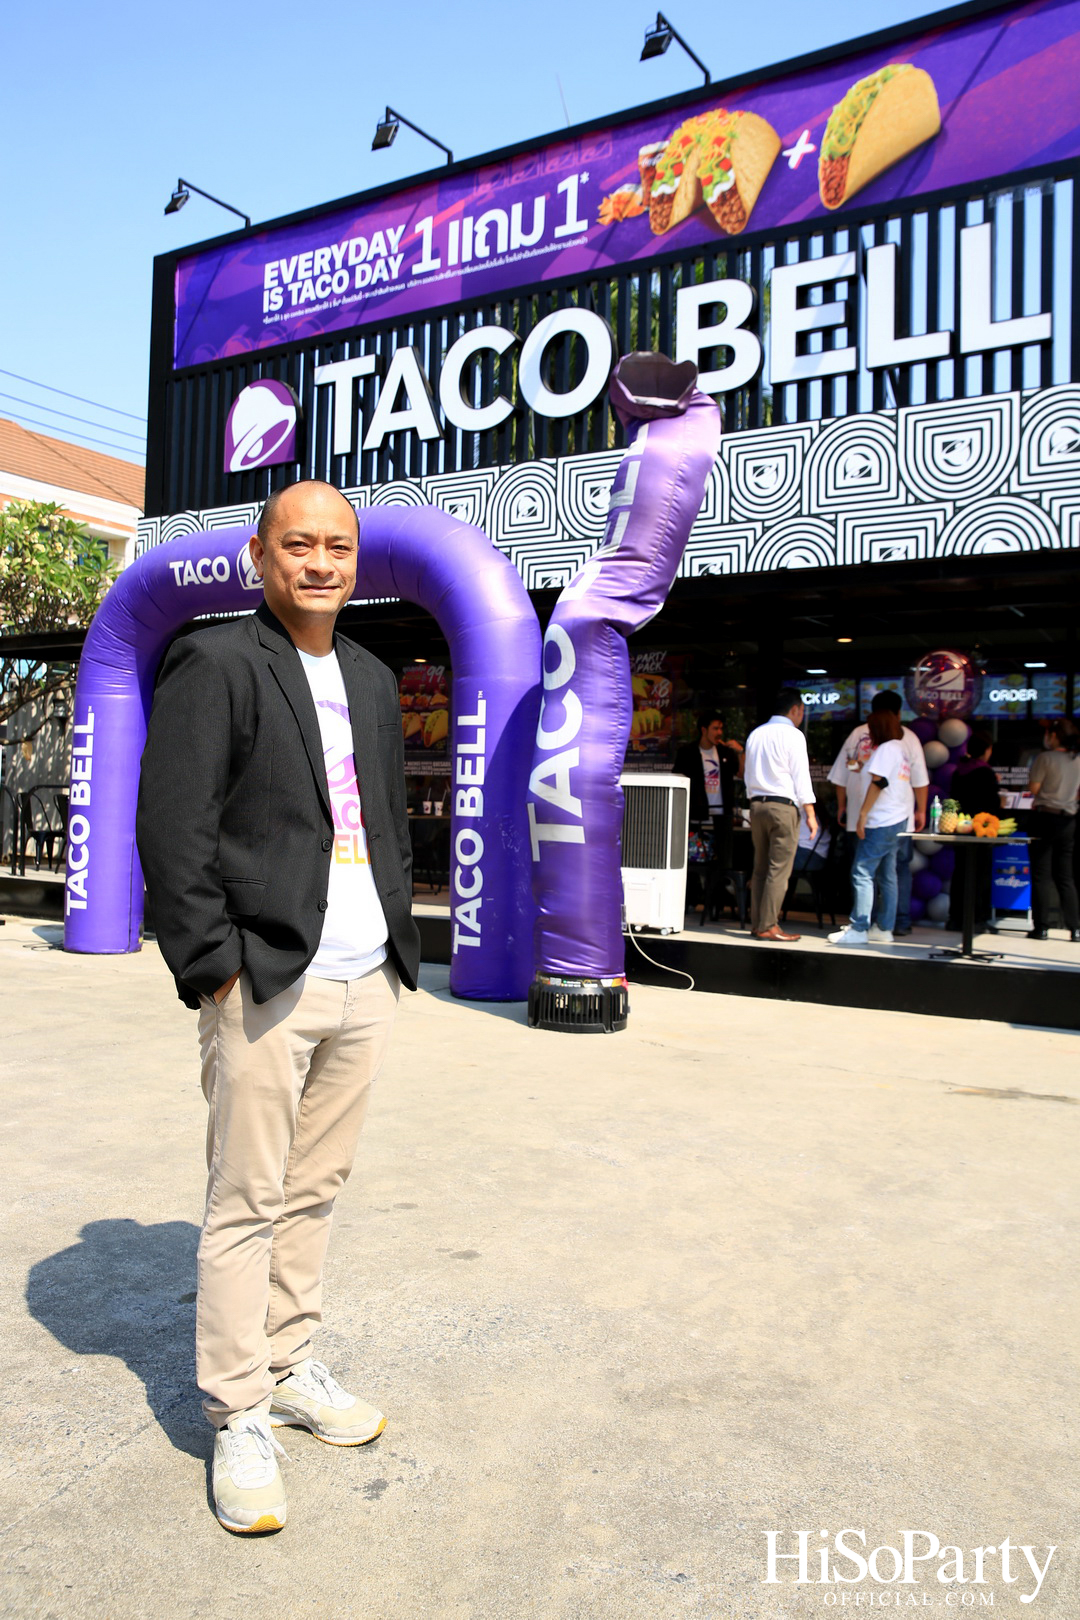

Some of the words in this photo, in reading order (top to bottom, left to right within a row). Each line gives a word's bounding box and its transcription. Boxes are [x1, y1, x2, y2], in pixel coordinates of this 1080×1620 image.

[263, 223, 407, 290] EVERYDAY
[411, 215, 441, 276] 1
[447, 195, 546, 267] แถม
[262, 287, 284, 314] IS
[288, 272, 350, 306] TACO
[354, 253, 406, 289] DAY
[314, 307, 612, 455] TACO
[675, 222, 1052, 395] BELL
[168, 555, 231, 587] TACO
[636, 651, 667, 663] PARTY
[637, 662, 662, 673] PACK
[822, 692, 841, 704] UP
[989, 688, 1038, 702] ORDER
[527, 623, 586, 863] TACO
[66, 813, 91, 917] TACO
[452, 827, 485, 955] TACO
